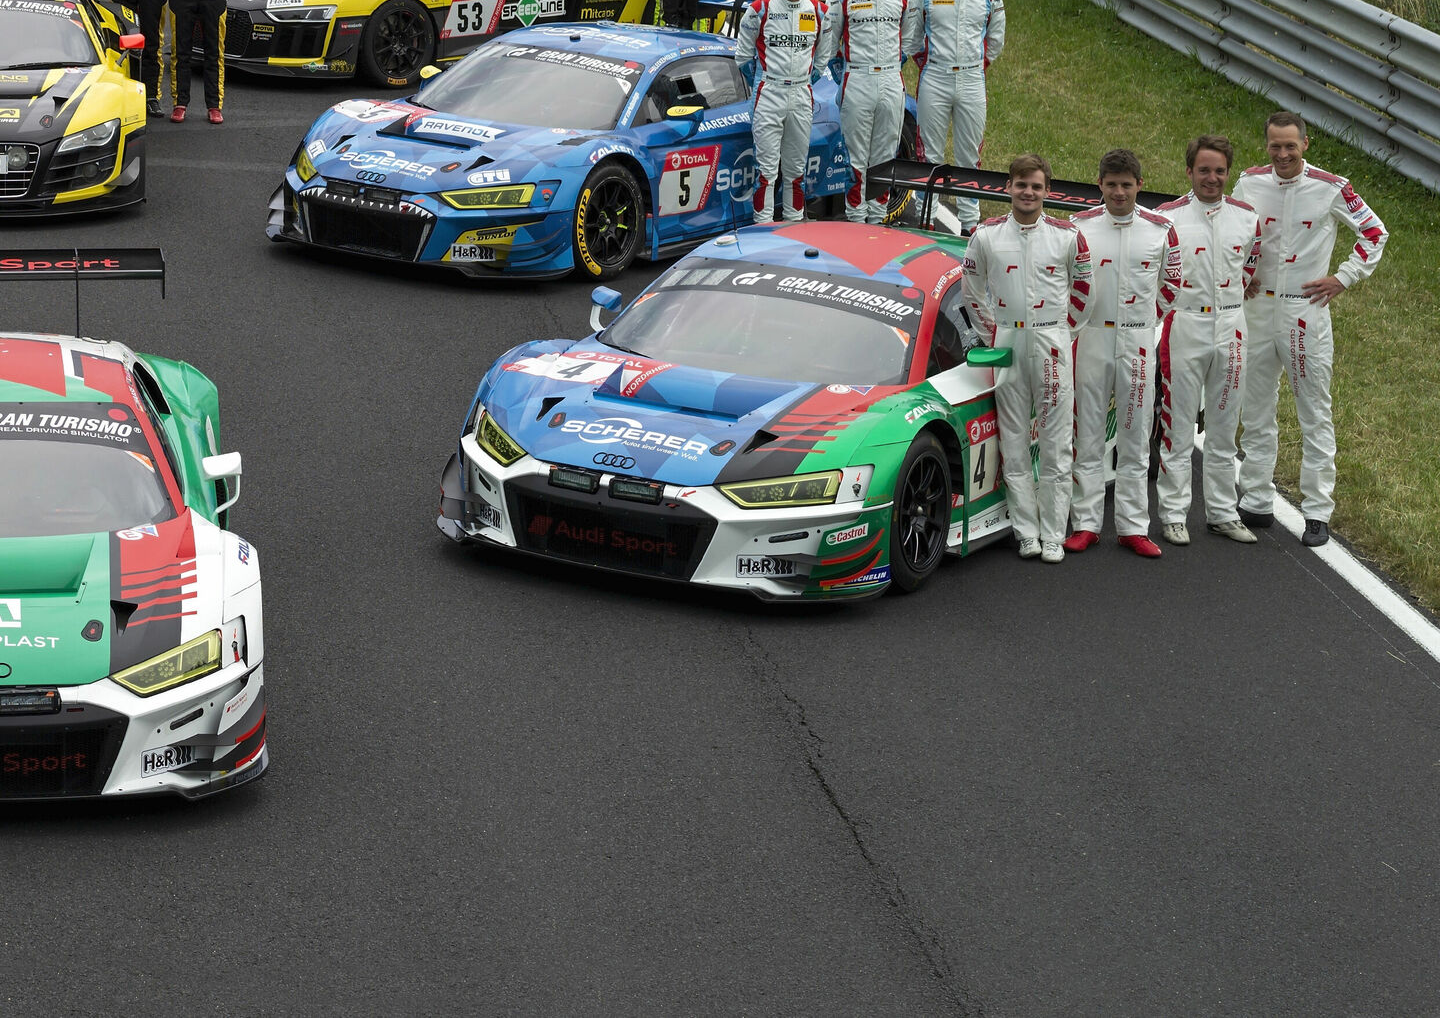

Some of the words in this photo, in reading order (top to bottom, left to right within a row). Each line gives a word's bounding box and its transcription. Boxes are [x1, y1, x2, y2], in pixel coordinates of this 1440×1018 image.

[457, 1, 483, 33] 53
[580, 7, 615, 20] Mitcaps
[799, 13, 816, 21] ADAC
[255, 24, 274, 32] MOTUL
[529, 27, 651, 48] SCHERER
[538, 51, 576, 62] GRAN
[423, 120, 491, 139] RAVENOL
[339, 151, 437, 176] SCHERER
[589, 142, 635, 164] FALKEN
[681, 152, 709, 165] TOTAL
[678, 170, 691, 207] 5
[476, 231, 517, 242] DUNLOP
[576, 195, 593, 268] DUNLOP
[0, 257, 120, 271] Sport
[778, 276, 828, 294] GRAN
[935, 275, 948, 293] KAFFER
[775, 286, 792, 294] THE
[793, 289, 816, 298] REAL
[817, 293, 852, 305] DRIVING
[853, 301, 904, 323] SIMULATOR
[1234, 342, 1242, 364] Audi
[1298, 331, 1307, 353] Audi
[557, 361, 591, 379] 4
[598, 354, 644, 368] TOTAL
[1051, 359, 1059, 381] Audi
[1298, 354, 1307, 378] Sport
[626, 362, 673, 396] NORDRHEIN
[1043, 358, 1051, 403] customer
[1232, 365, 1242, 390] Sport
[1292, 371, 1300, 398] racing
[1136, 382, 1146, 408] Sport
[1218, 384, 1232, 411] racing
[1040, 403, 1049, 429] racing
[1125, 403, 1135, 430] racing
[25, 427, 68, 435] DRIVING
[70, 430, 129, 444] SIMULATOR
[561, 420, 710, 456] SCHERER
[621, 439, 640, 449] Autos
[642, 442, 655, 451] sind
[656, 446, 679, 456] unsere
[681, 450, 698, 462] Welt.
[973, 442, 985, 490] 4
[555, 519, 605, 544] Audi
[611, 531, 678, 557] Sport
[836, 526, 866, 544] Castrol
[738, 556, 773, 573] H&R
[3, 751, 87, 775] Sport
[144, 748, 175, 771] H&R
